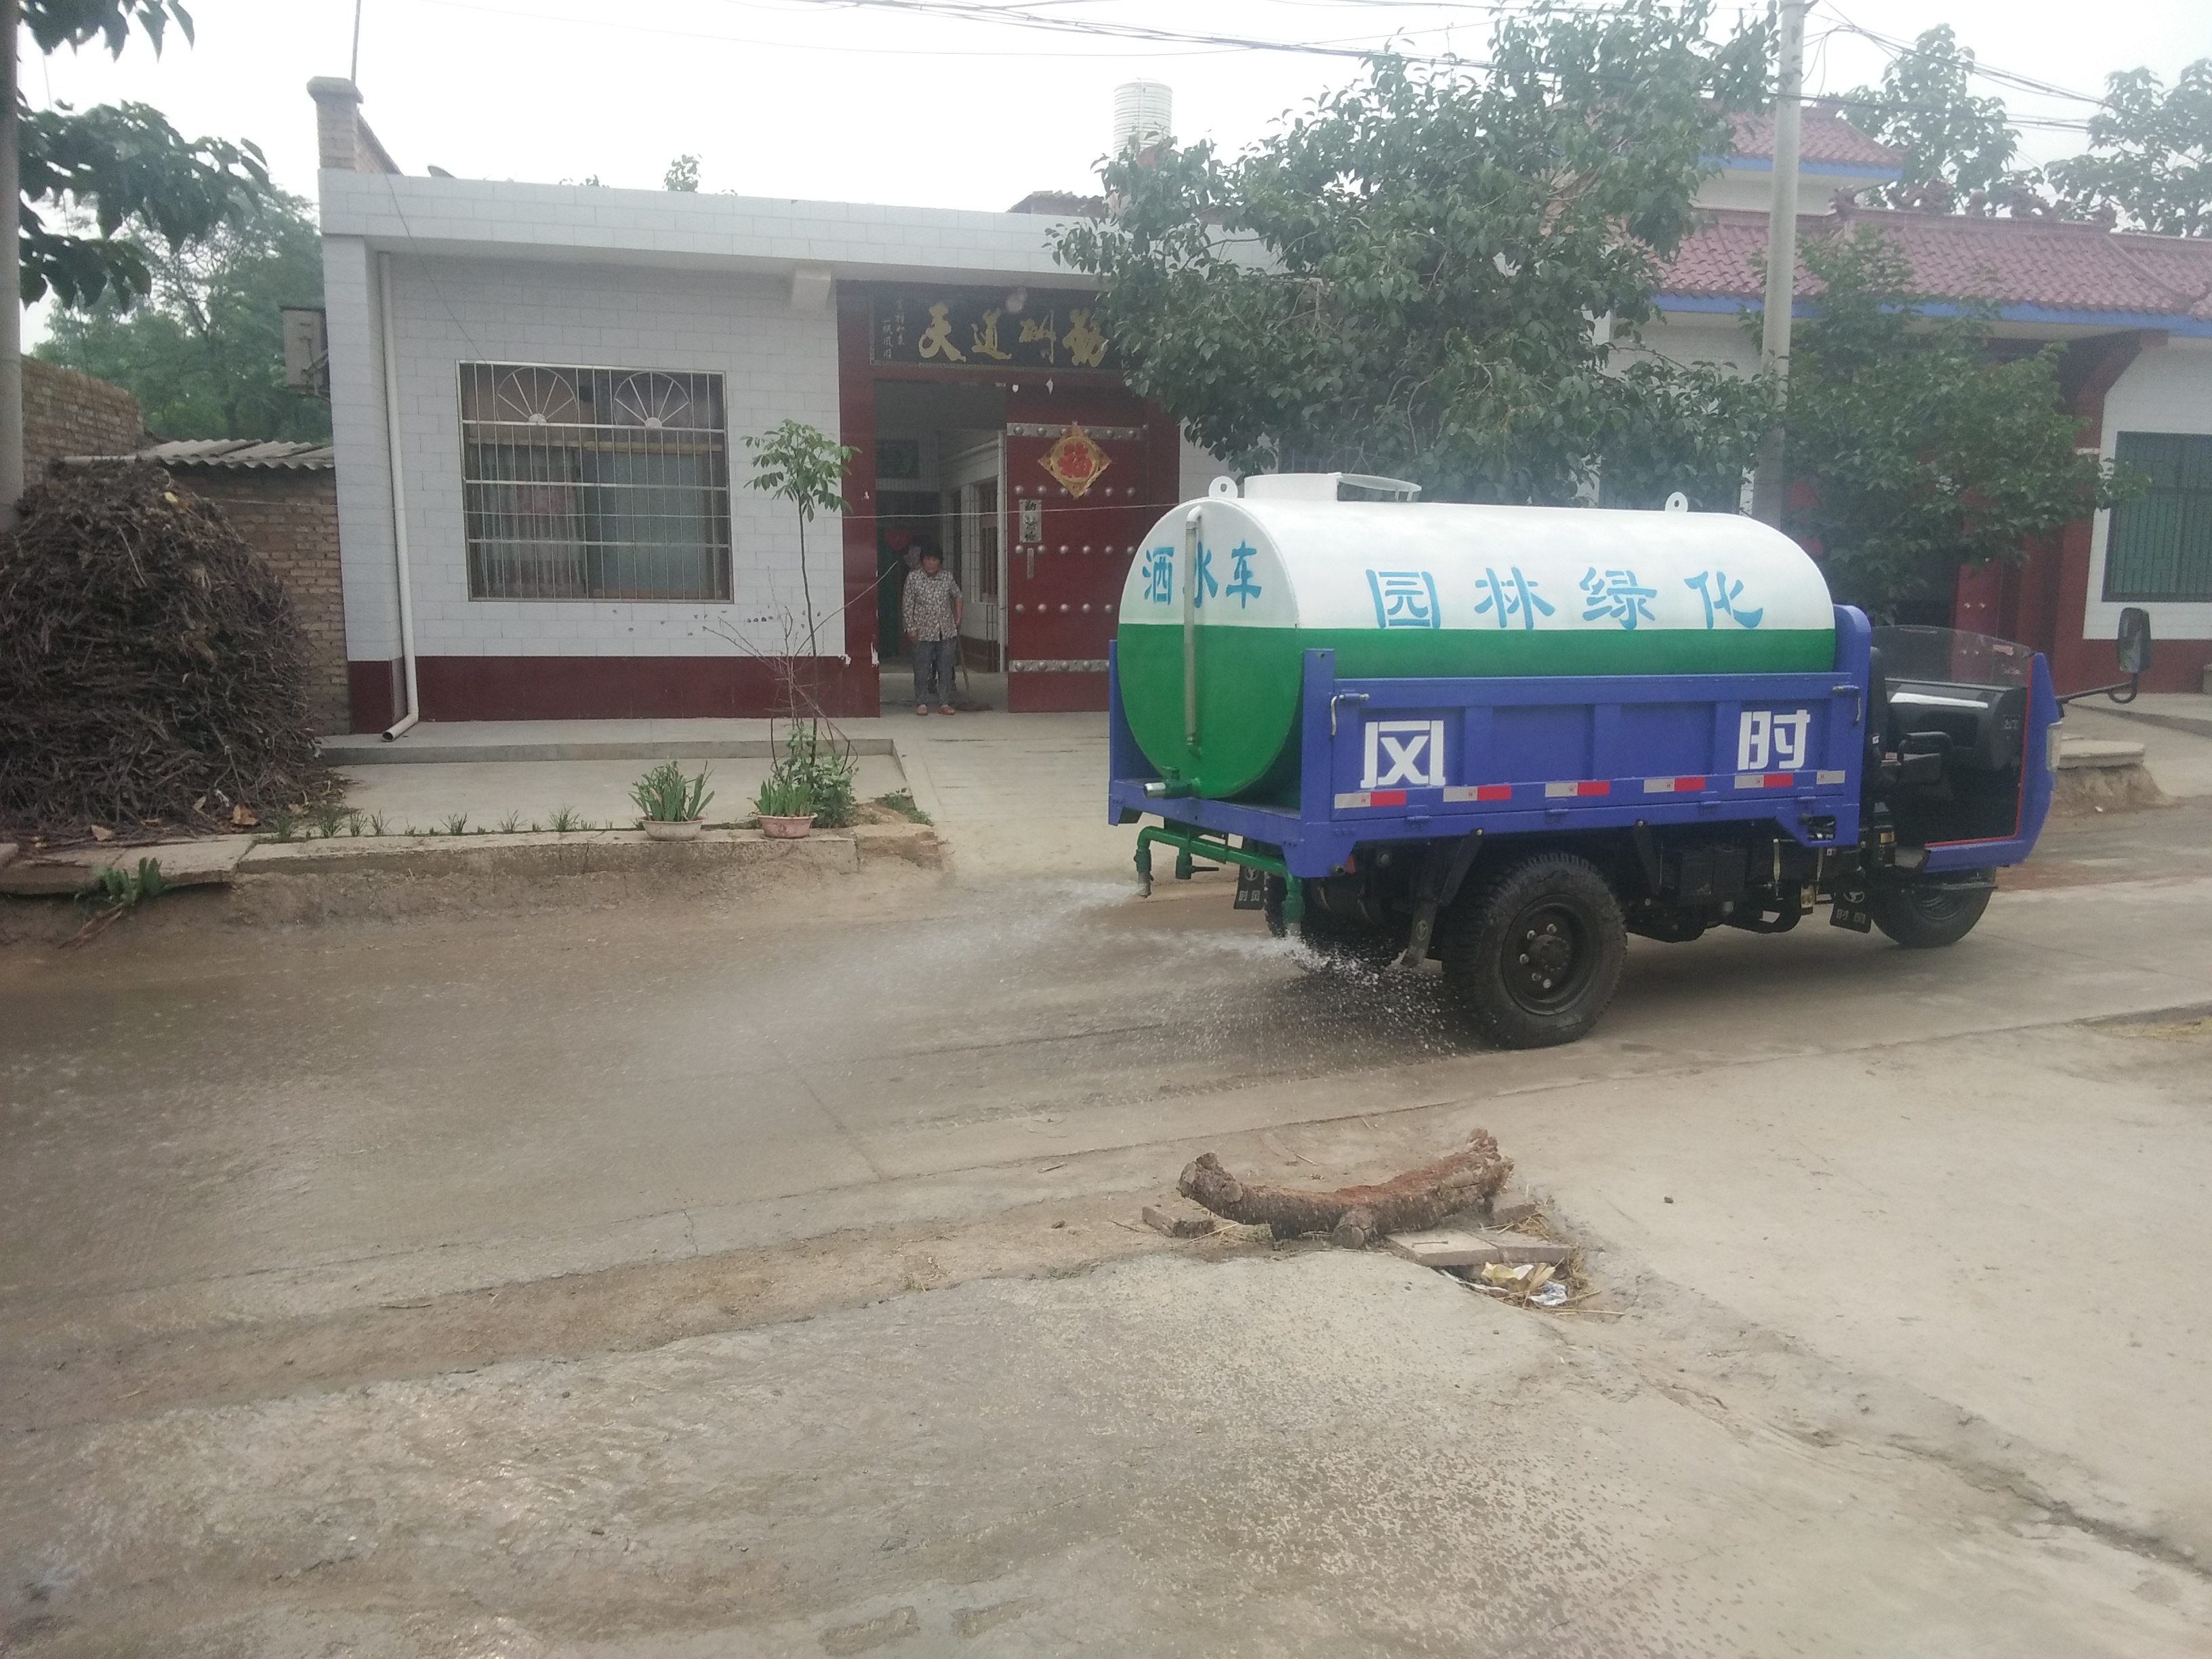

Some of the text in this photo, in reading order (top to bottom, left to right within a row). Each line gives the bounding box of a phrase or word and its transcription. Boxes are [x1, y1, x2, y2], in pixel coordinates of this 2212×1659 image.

[918, 302, 1109, 368] 天道酬勤
[1142, 539, 1262, 609] 洒水车
[1365, 566, 1764, 630] 园林绿化
[1737, 708, 1811, 771] 时
